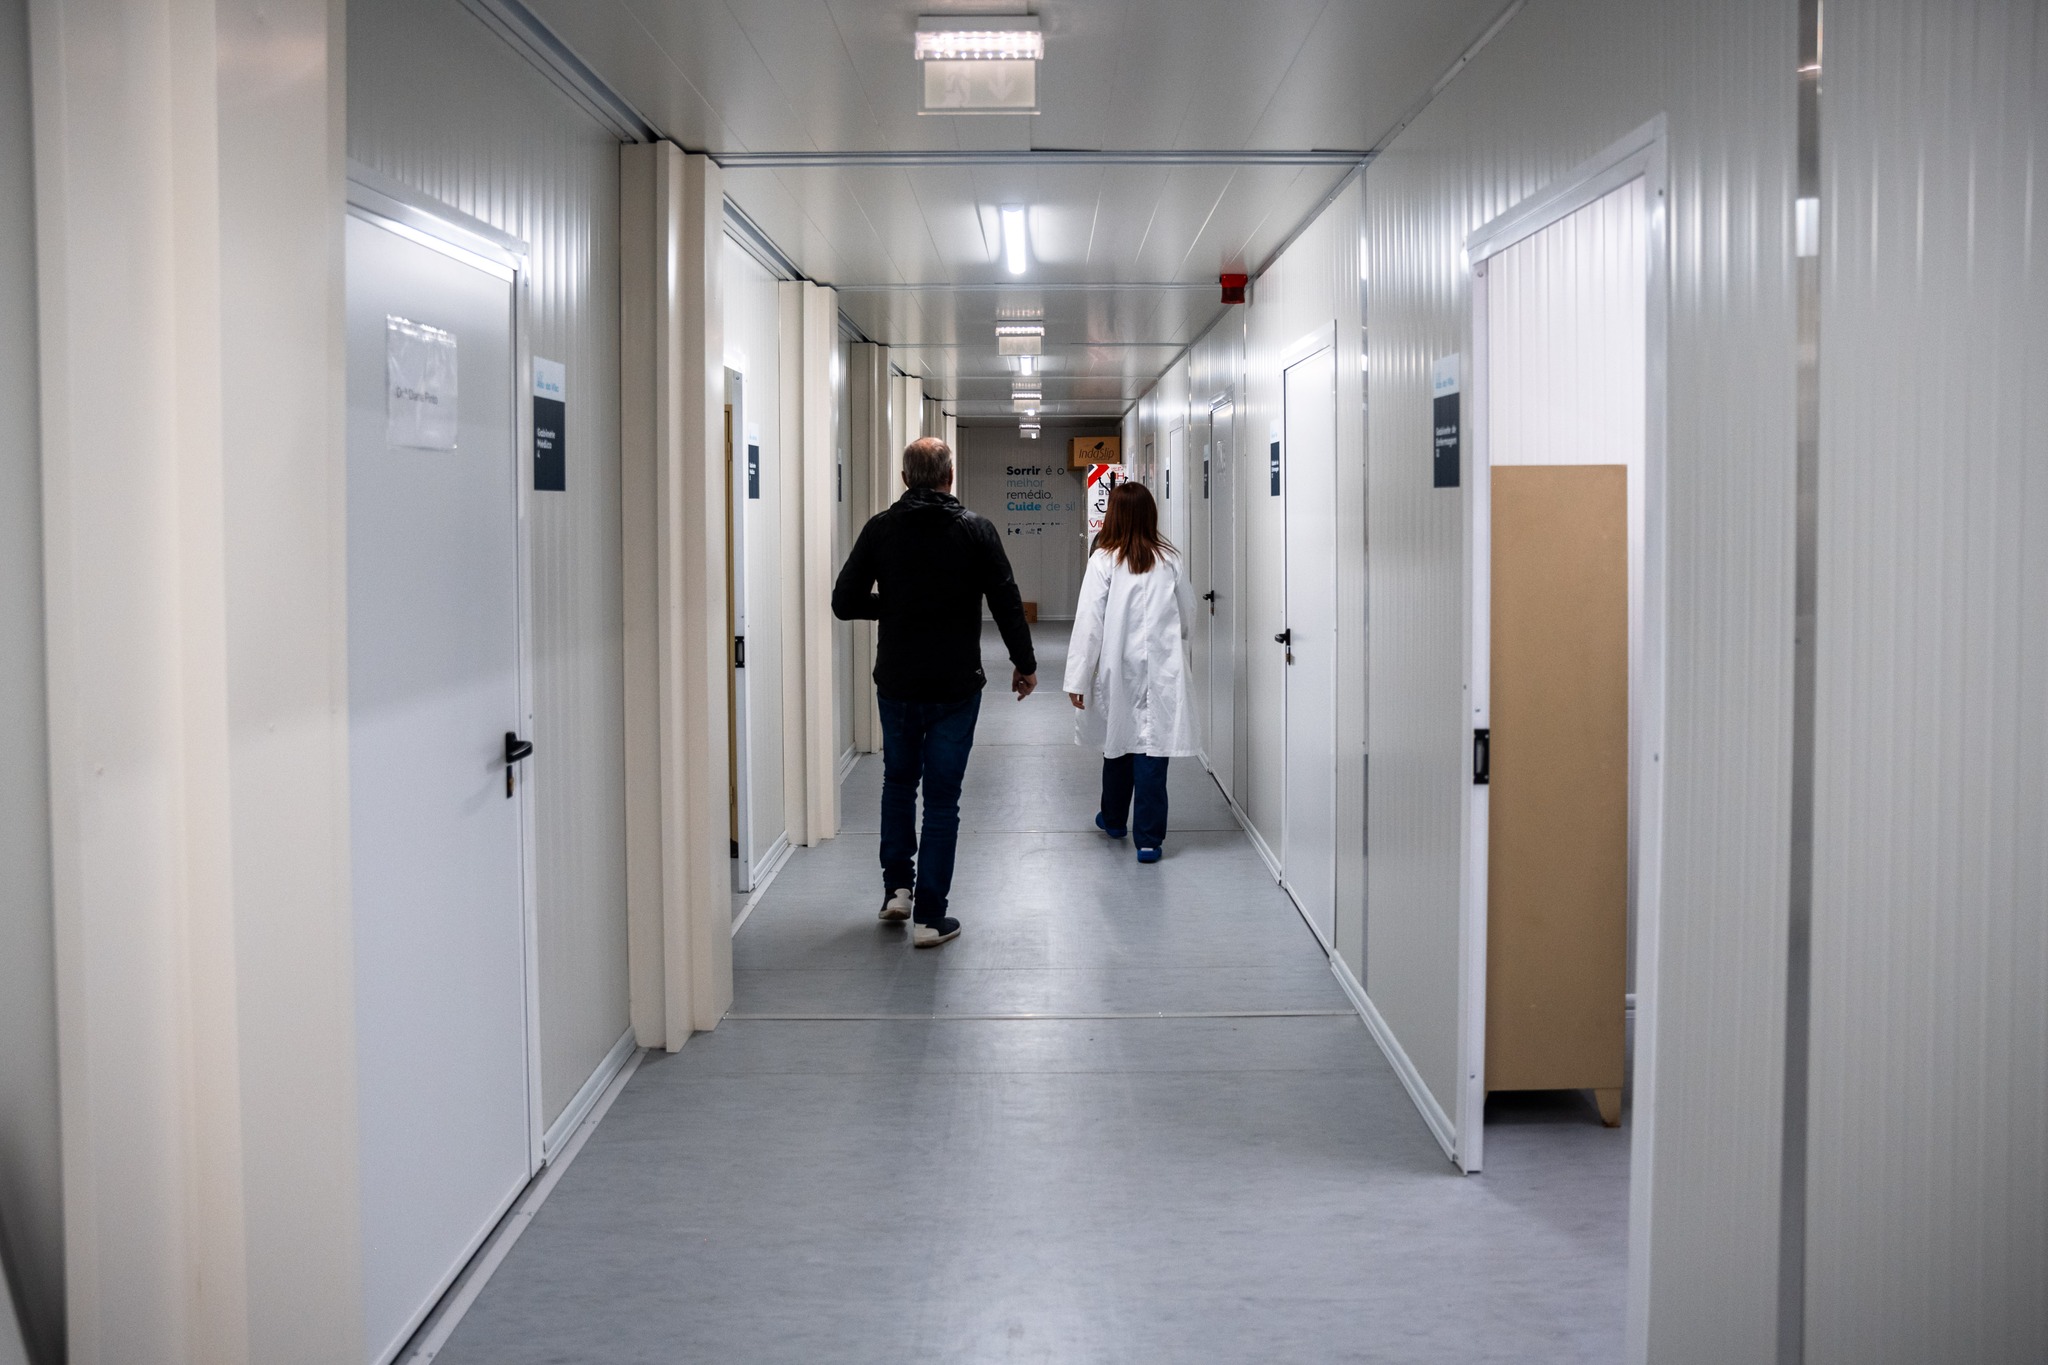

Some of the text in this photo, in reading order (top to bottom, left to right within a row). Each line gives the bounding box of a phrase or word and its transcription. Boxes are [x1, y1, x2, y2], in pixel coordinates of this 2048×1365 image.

[1078, 447, 1115, 460] IndaSlip
[1006, 465, 1065, 476] Sorrir é o
[1006, 477, 1045, 487] melhor
[1006, 489, 1053, 499] remédio.
[1007, 501, 1042, 511] Cuide
[1045, 501, 1061, 511] de
